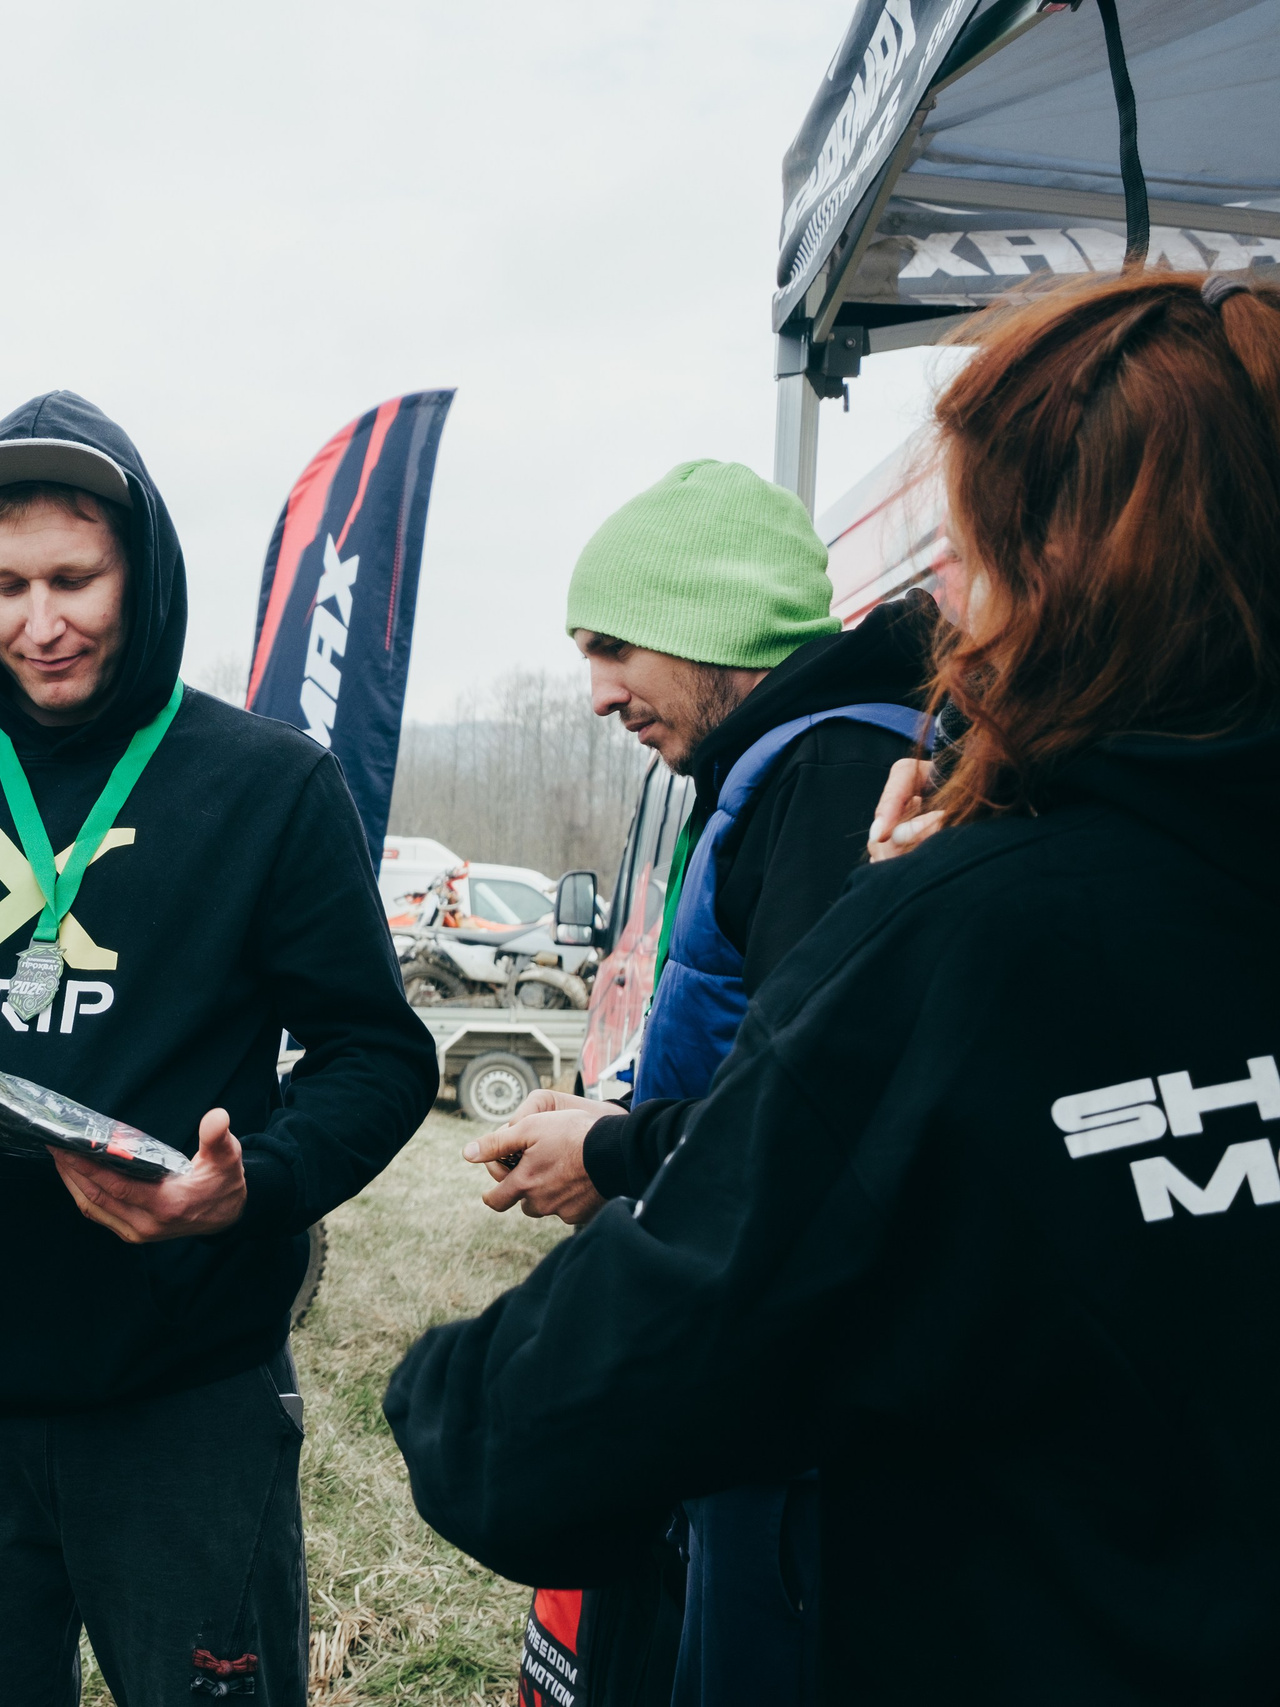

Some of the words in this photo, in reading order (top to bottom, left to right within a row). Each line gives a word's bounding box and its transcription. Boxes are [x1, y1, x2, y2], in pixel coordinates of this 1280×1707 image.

[1130, 1138, 1280, 1222] M
[525, 1654, 575, 1707] MOTION
[527, 1618, 578, 1685] FREEDOM
